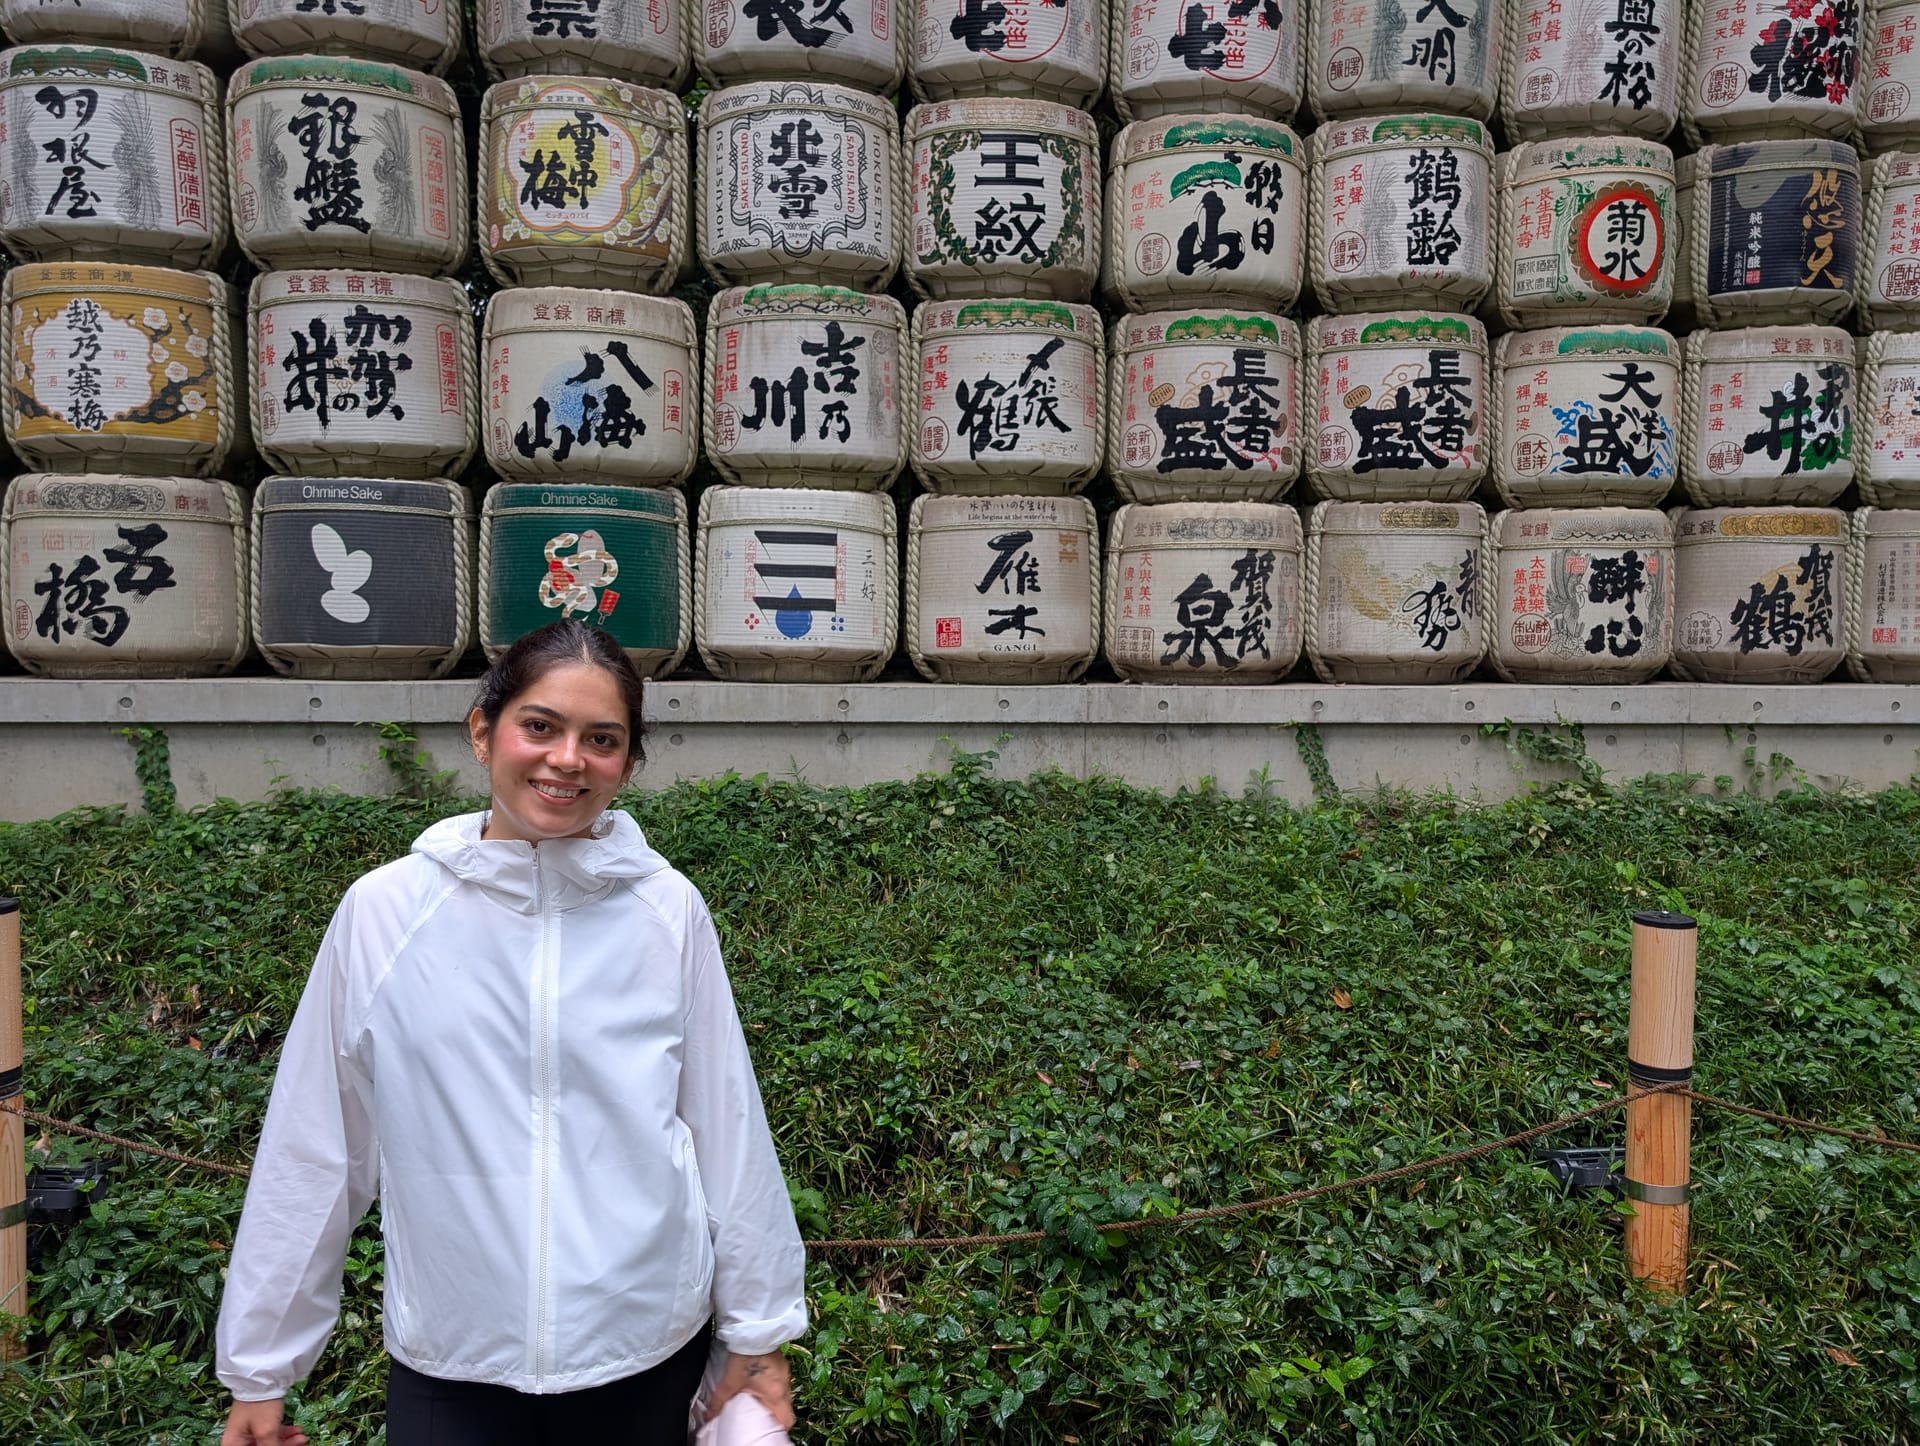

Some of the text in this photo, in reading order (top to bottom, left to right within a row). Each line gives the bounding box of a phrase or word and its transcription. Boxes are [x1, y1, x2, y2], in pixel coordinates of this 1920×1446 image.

[786, 96, 806, 104] 1872
[35, 86, 114, 218] 羽根屋
[1332, 126, 1369, 149] 登録
[174, 127, 201, 219] 芳醇清酒
[715, 130, 724, 239] HOKUSETSU
[741, 132, 749, 209] SAKE ISLAND
[768, 118, 828, 219] 北雪
[846, 135, 856, 213] SADO ISLAND
[873, 135, 882, 243] HOKUSETSU
[970, 133, 1047, 257] 王紋
[1535, 186, 1555, 241] 長生自得
[1747, 211, 1763, 268] 純米吟醸
[1346, 237, 1360, 265] 青木
[1599, 201, 1648, 283] 菊水
[287, 275, 394, 295] 登録商標
[533, 303, 627, 325] 登録商標
[1322, 328, 1358, 348] 登録
[66, 299, 109, 431] 越乃寒梅
[666, 379, 681, 423] 清酒
[1517, 441, 1531, 471] 酒造
[1532, 440, 1548, 470] 大洋
[302, 486, 383, 500] Ohmine Sake
[541, 492, 618, 506] Ohmine Sake
[982, 513, 1003, 521] begins
[975, 530, 1046, 640] 雁木
